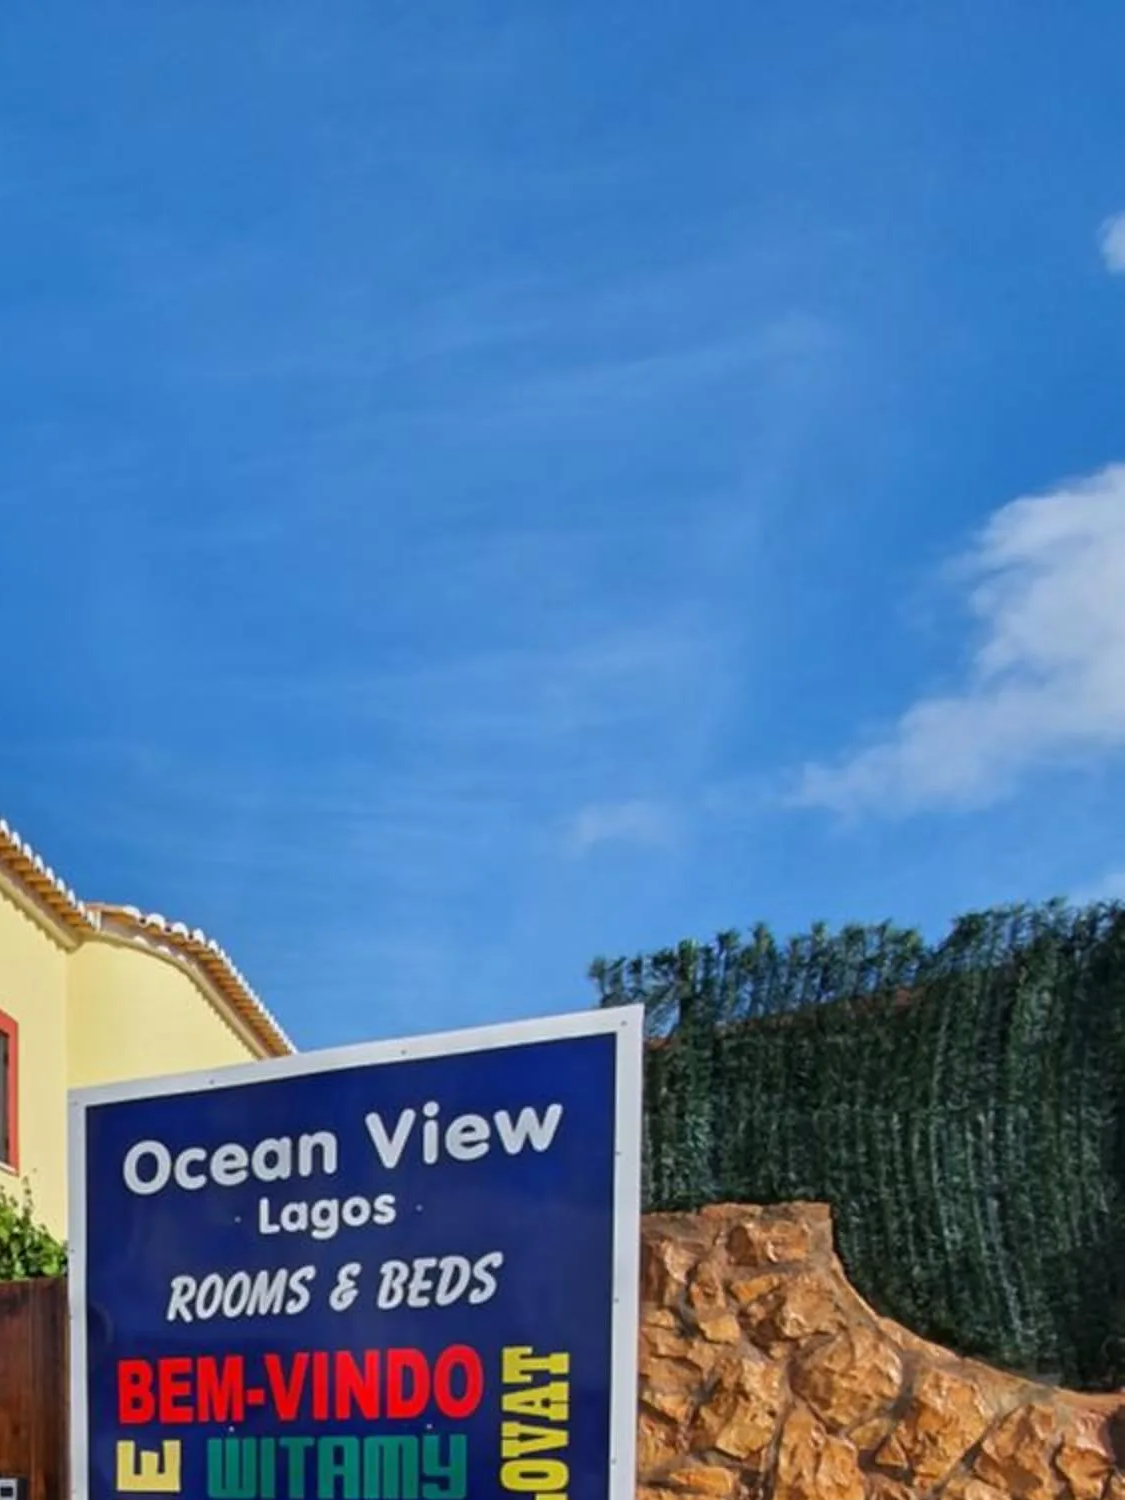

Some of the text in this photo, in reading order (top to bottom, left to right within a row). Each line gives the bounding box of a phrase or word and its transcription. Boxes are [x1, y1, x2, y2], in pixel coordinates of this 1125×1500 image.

[123, 1101, 563, 1195] Ocean View
[258, 1195, 396, 1240] Lagos
[166, 1251, 504, 1324] ROOMS & BEDS
[117, 1344, 484, 1425] BEM-VINDO
[207, 1434, 467, 1500] WITAMY
